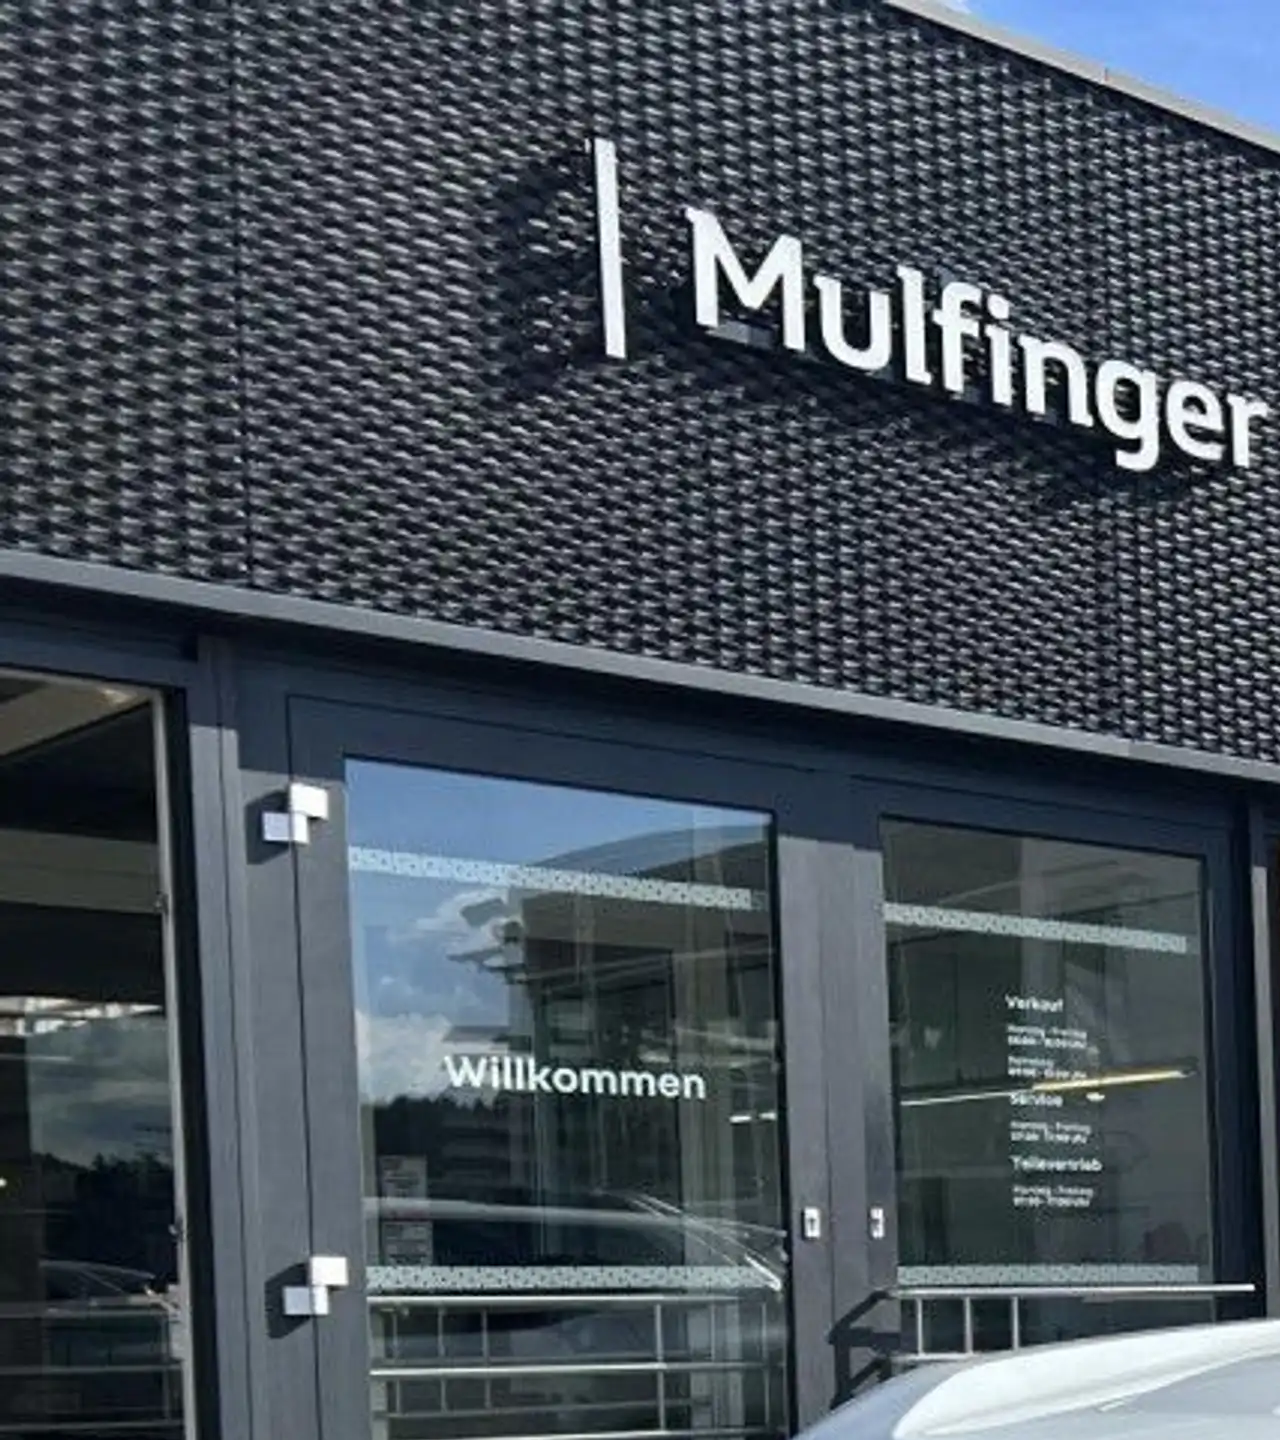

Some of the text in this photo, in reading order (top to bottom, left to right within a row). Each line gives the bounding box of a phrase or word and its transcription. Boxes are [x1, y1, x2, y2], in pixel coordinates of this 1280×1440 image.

[686, 206, 1268, 472] Mulfinger
[1005, 994, 1064, 1013] Verkauf
[444, 1055, 706, 1099] Willkommen
